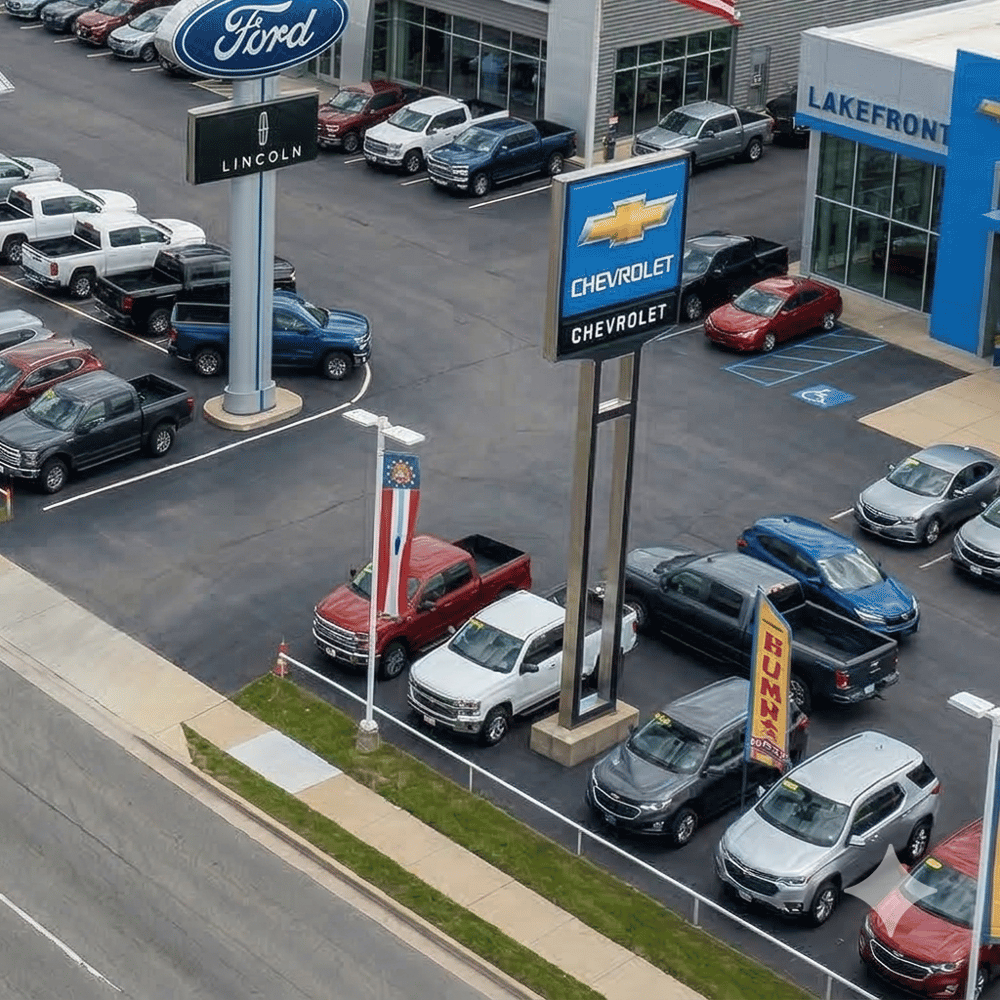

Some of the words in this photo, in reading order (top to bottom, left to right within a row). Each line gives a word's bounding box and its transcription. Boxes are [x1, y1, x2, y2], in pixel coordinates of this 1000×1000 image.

[213, 0, 317, 61] Ford
[808, 85, 950, 145] LAKEFRONT
[222, 145, 302, 172] LINCOLN
[570, 254, 674, 298] CHEVROLET
[571, 304, 667, 344] CHEVROLET
